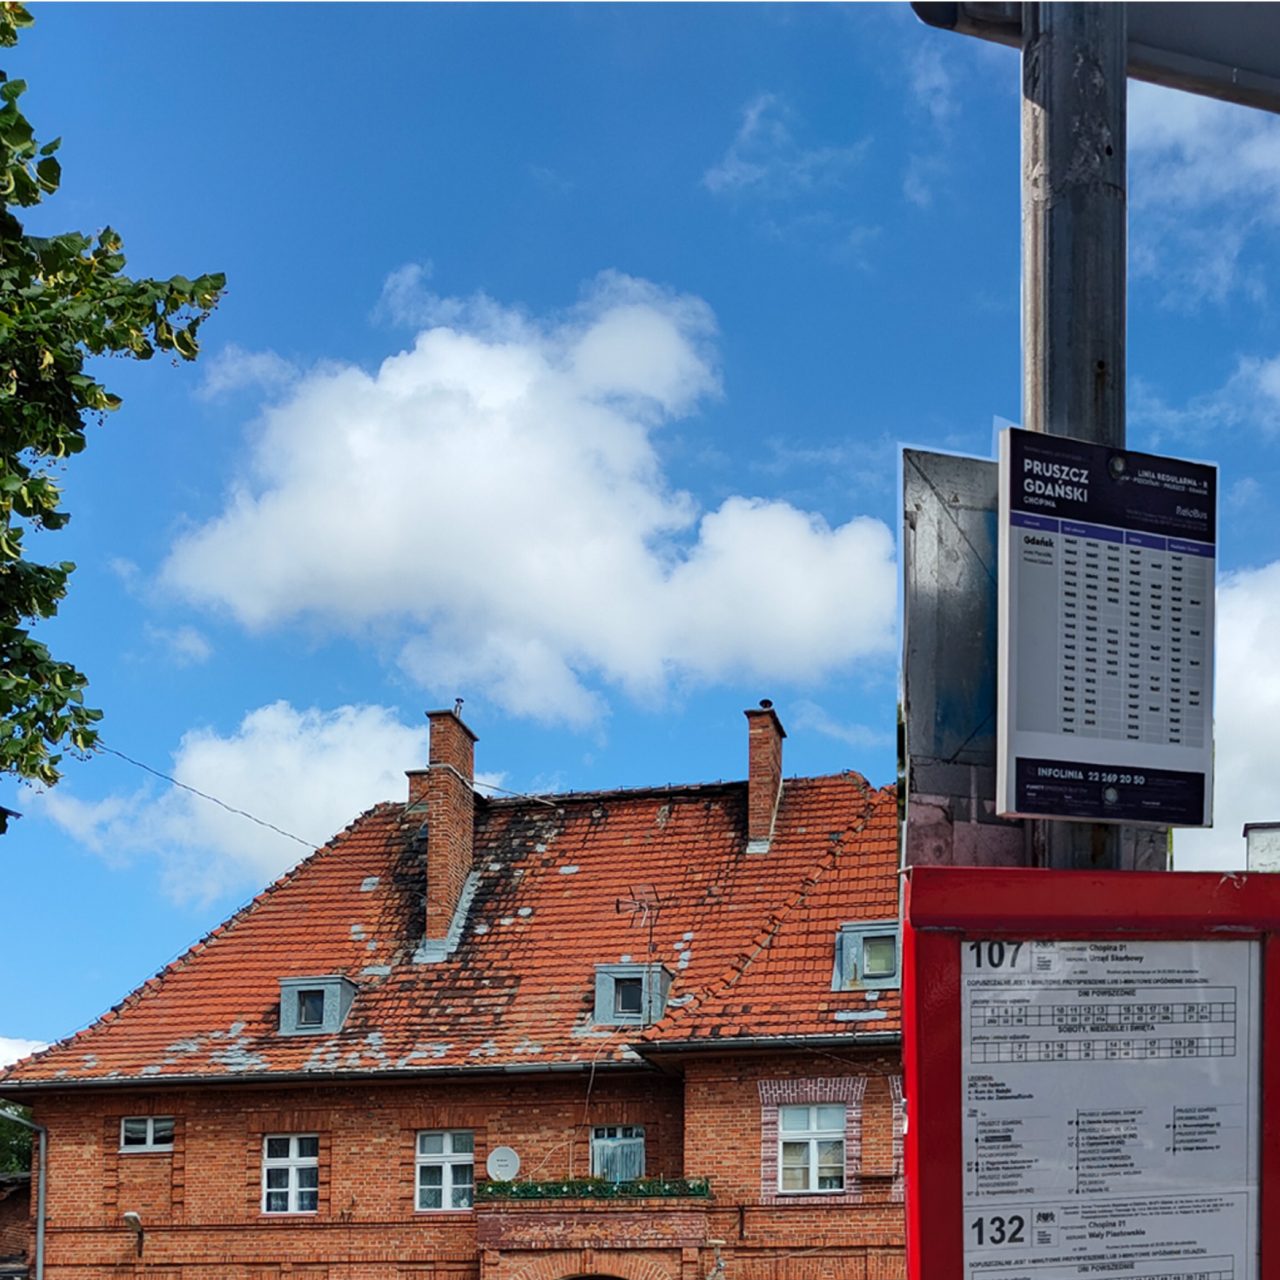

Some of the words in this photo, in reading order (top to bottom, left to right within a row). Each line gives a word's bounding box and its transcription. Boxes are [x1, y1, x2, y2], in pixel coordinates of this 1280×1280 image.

[1024, 458, 1088, 484] PRUSZCZ
[1024, 478, 1088, 502] GDAŃSKI
[1024, 536, 1054, 548] Gdańsk
[1038, 767, 1084, 780] INFOLINIA
[1088, 772, 1099, 782] 22
[1102, 772, 1118, 783] 269
[1120, 774, 1131, 784] 20
[1134, 775, 1145, 785] 50
[970, 942, 1024, 968] 107
[972, 1215, 1024, 1245] 132
